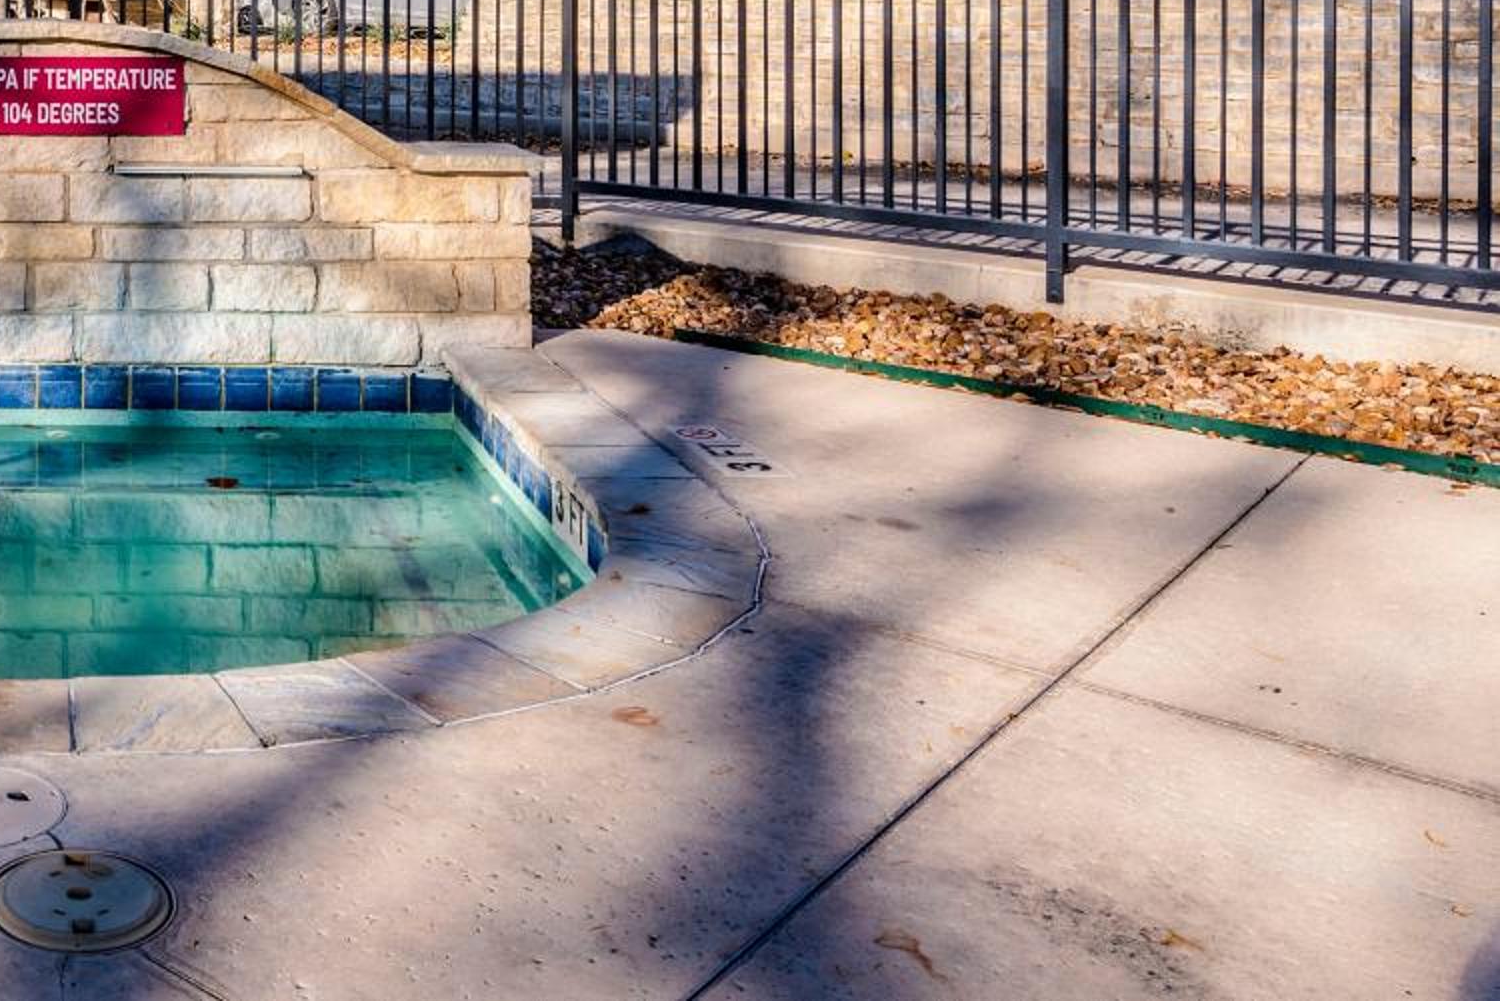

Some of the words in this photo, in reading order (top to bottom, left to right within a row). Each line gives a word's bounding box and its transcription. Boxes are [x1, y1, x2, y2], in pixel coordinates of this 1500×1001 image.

[23, 67, 41, 90] IF
[44, 67, 177, 91] TEMPERATURE
[2, 101, 33, 124] 104
[37, 101, 120, 124] DEGREES
[697, 441, 755, 457] FT
[726, 462, 773, 472] 3
[555, 480, 565, 524] 3
[568, 491, 585, 546] FT
